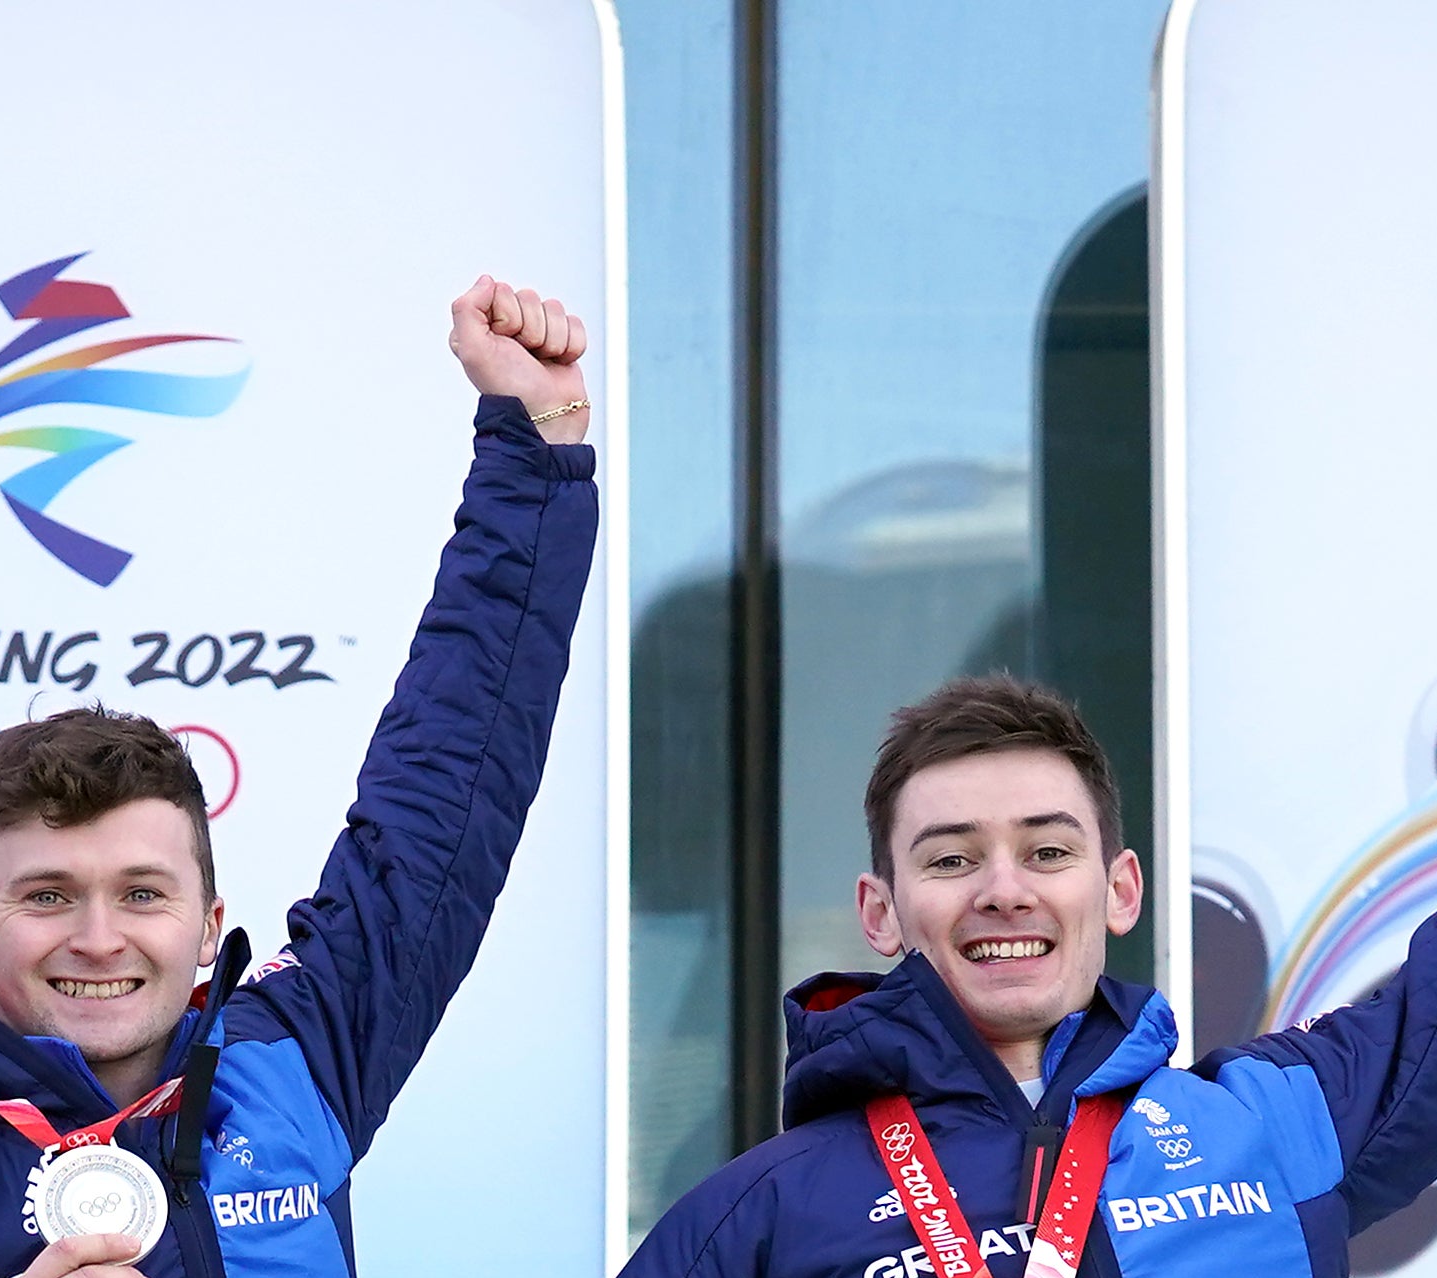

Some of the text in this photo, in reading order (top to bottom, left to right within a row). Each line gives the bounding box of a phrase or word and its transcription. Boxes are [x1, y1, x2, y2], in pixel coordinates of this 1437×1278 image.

[126, 630, 336, 689] 2022
[212, 1181, 320, 1228] BRITAIN
[900, 1154, 939, 1210] 2022
[1108, 1181, 1272, 1232] BRITAIN
[919, 1207, 972, 1278] BEIJING
